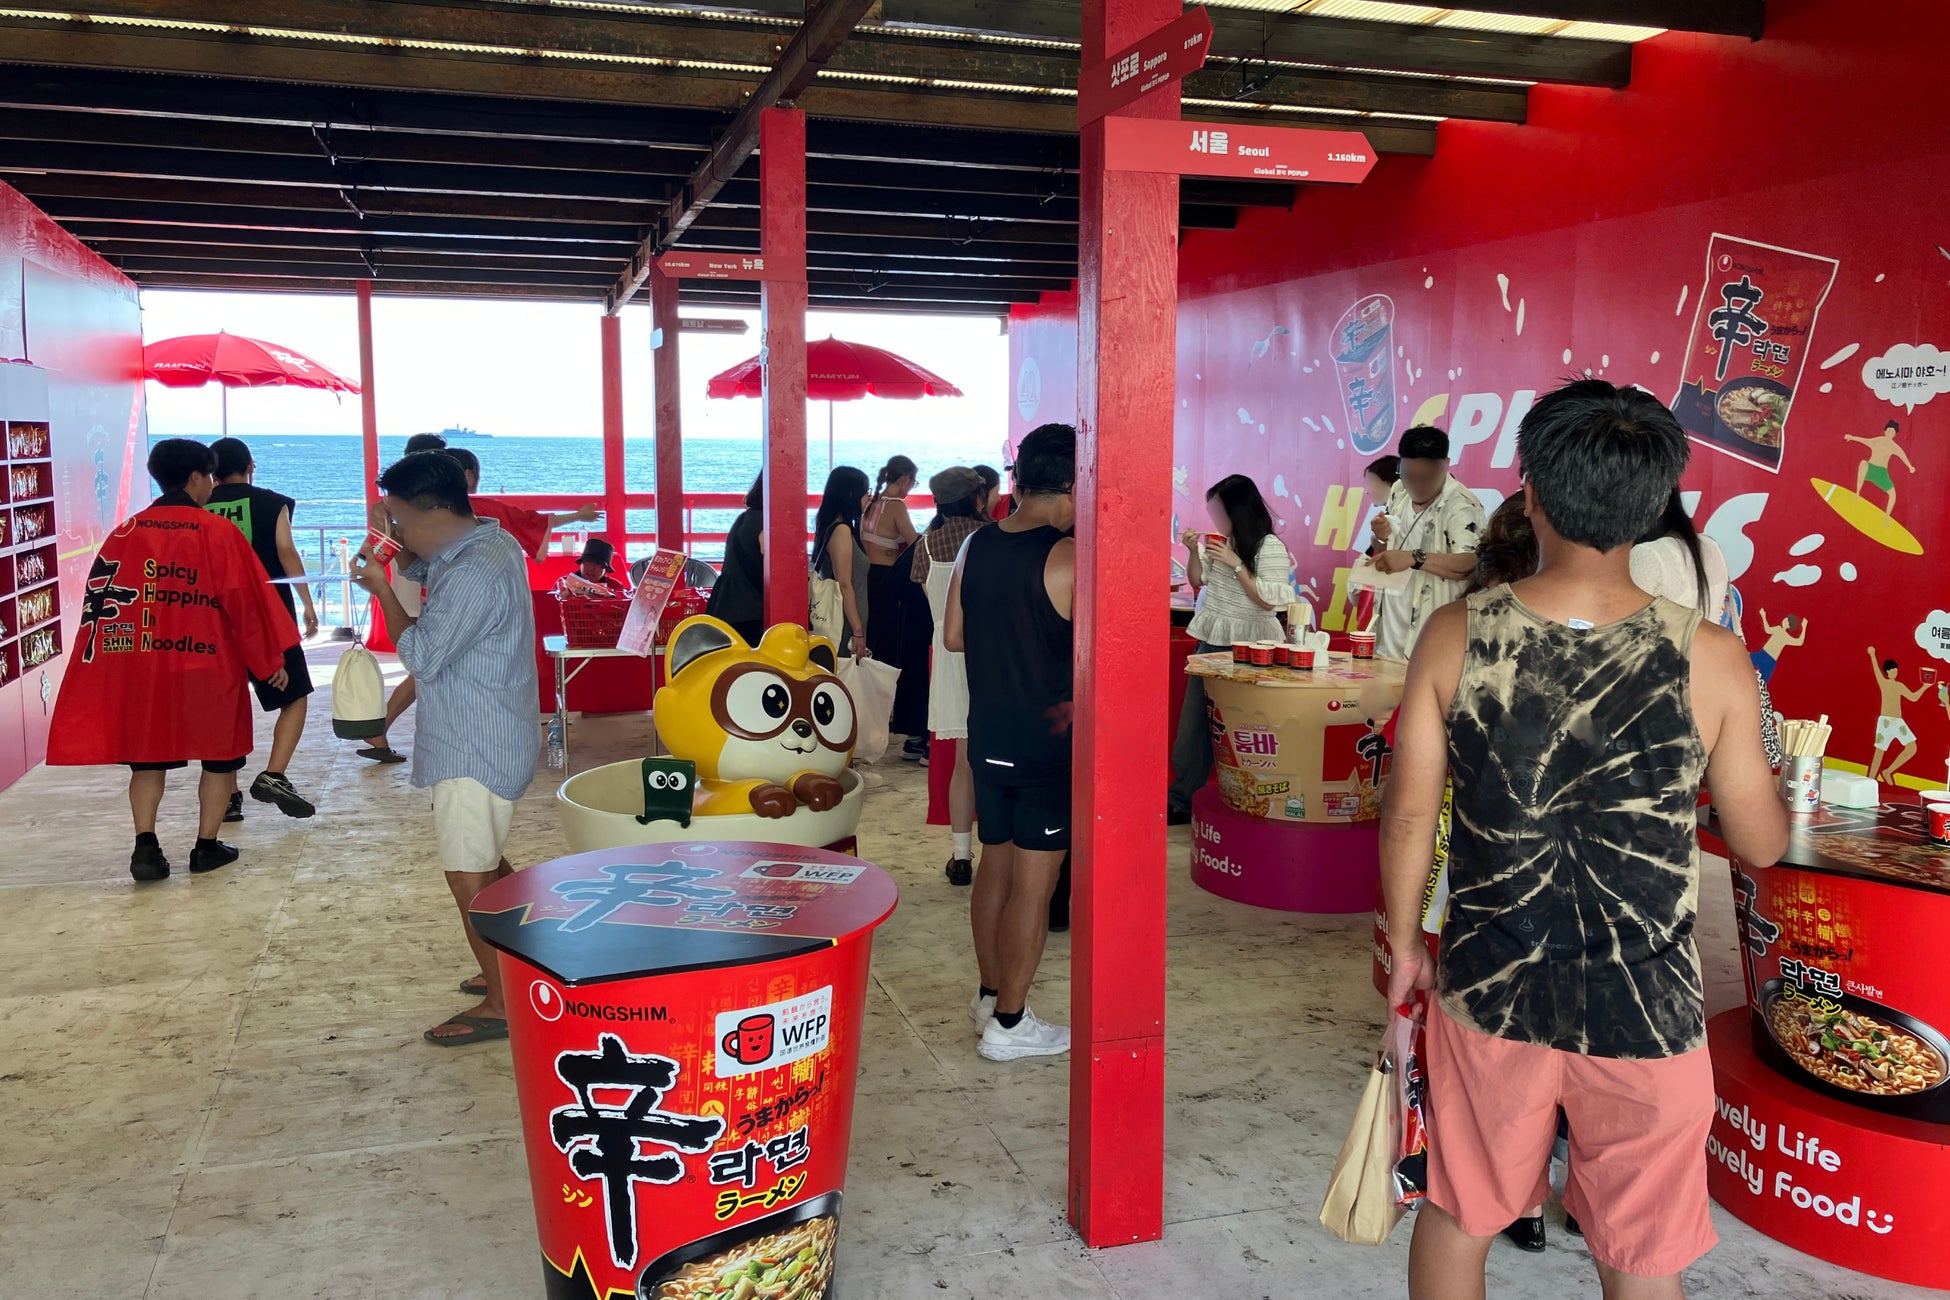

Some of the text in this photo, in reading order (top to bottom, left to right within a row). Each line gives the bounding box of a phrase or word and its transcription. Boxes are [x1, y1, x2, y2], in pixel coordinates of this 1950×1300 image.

[1111, 51, 1140, 88] 삿포로
[1143, 51, 1168, 72] Sapporo
[1189, 130, 1229, 155] 서울
[1238, 145, 1270, 157] Seoul
[1327, 152, 1366, 163] 1.160km
[1253, 167, 1276, 176] Global
[1287, 169, 1309, 177] POPUP
[1708, 275, 1769, 382] 辛
[1752, 338, 1791, 364] 라면
[1751, 360, 1784, 378] ラーメン
[1875, 366, 1913, 379] 에노시마
[136, 519, 200, 531] NONGSHIM
[143, 558, 198, 586] Spicy
[102, 622, 135, 636] 라면
[142, 607, 156, 628] In
[102, 636, 134, 647] SHIN
[141, 631, 217, 655] Noodles
[1233, 729, 1281, 756] 툼바
[1256, 780, 1290, 797] 焼きそば
[1200, 820, 1222, 844] Life
[1200, 847, 1229, 874] Food
[804, 870, 855, 880] WFP
[682, 901, 798, 919] 라면
[1778, 956, 1884, 999] 라면 큰사발면
[1783, 981, 1842, 1014] ラーメン
[565, 999, 668, 1022] NONGSHIM
[781, 1013, 827, 1047] WFP
[549, 1032, 727, 1271] 辛
[707, 1124, 811, 1188] 라면
[1777, 1123, 1841, 1172] Life
[561, 1183, 594, 1208] シン
[714, 1170, 808, 1221] ラーメン
[1774, 1171, 1862, 1228] Food
